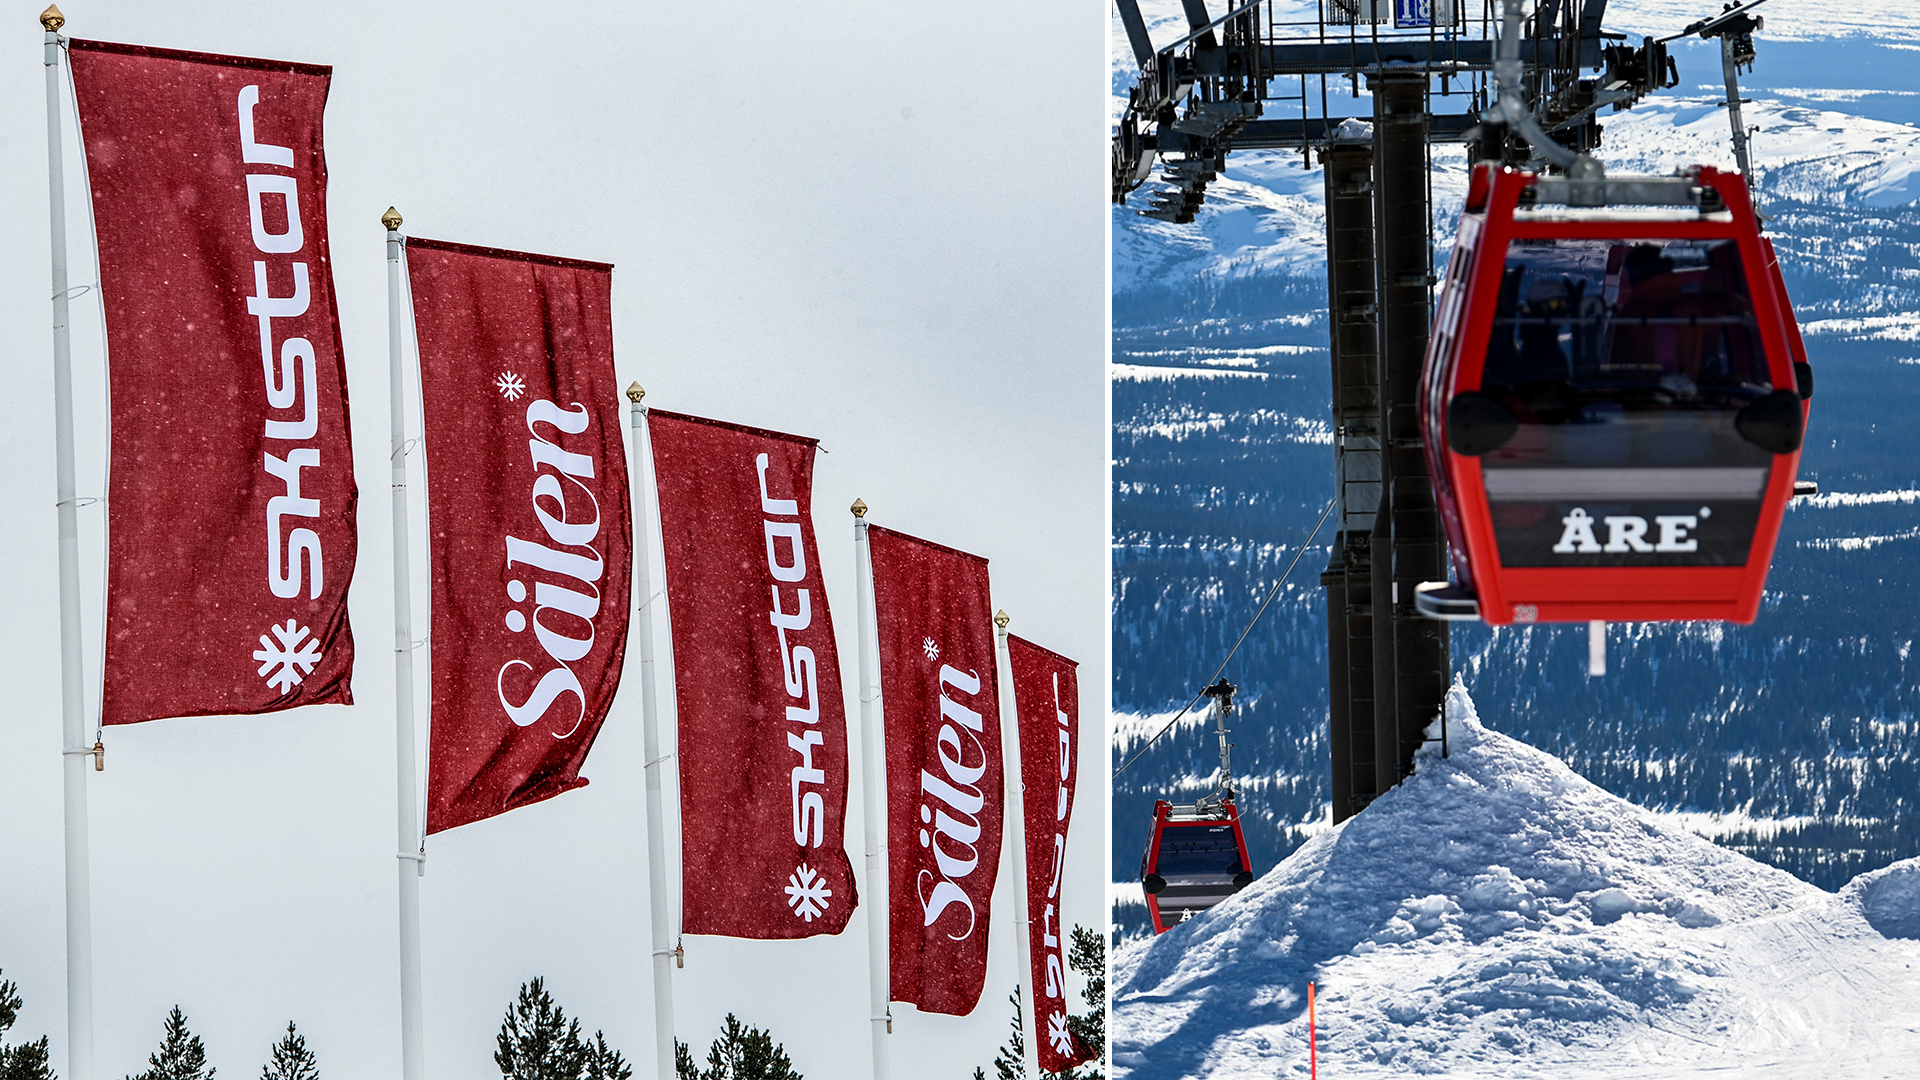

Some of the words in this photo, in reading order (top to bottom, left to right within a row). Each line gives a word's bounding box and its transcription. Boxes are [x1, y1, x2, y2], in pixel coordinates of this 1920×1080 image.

[498, 399, 604, 740] Sälen
[1552, 506, 1698, 554] ÅRE
[917, 664, 987, 941] Sälen
